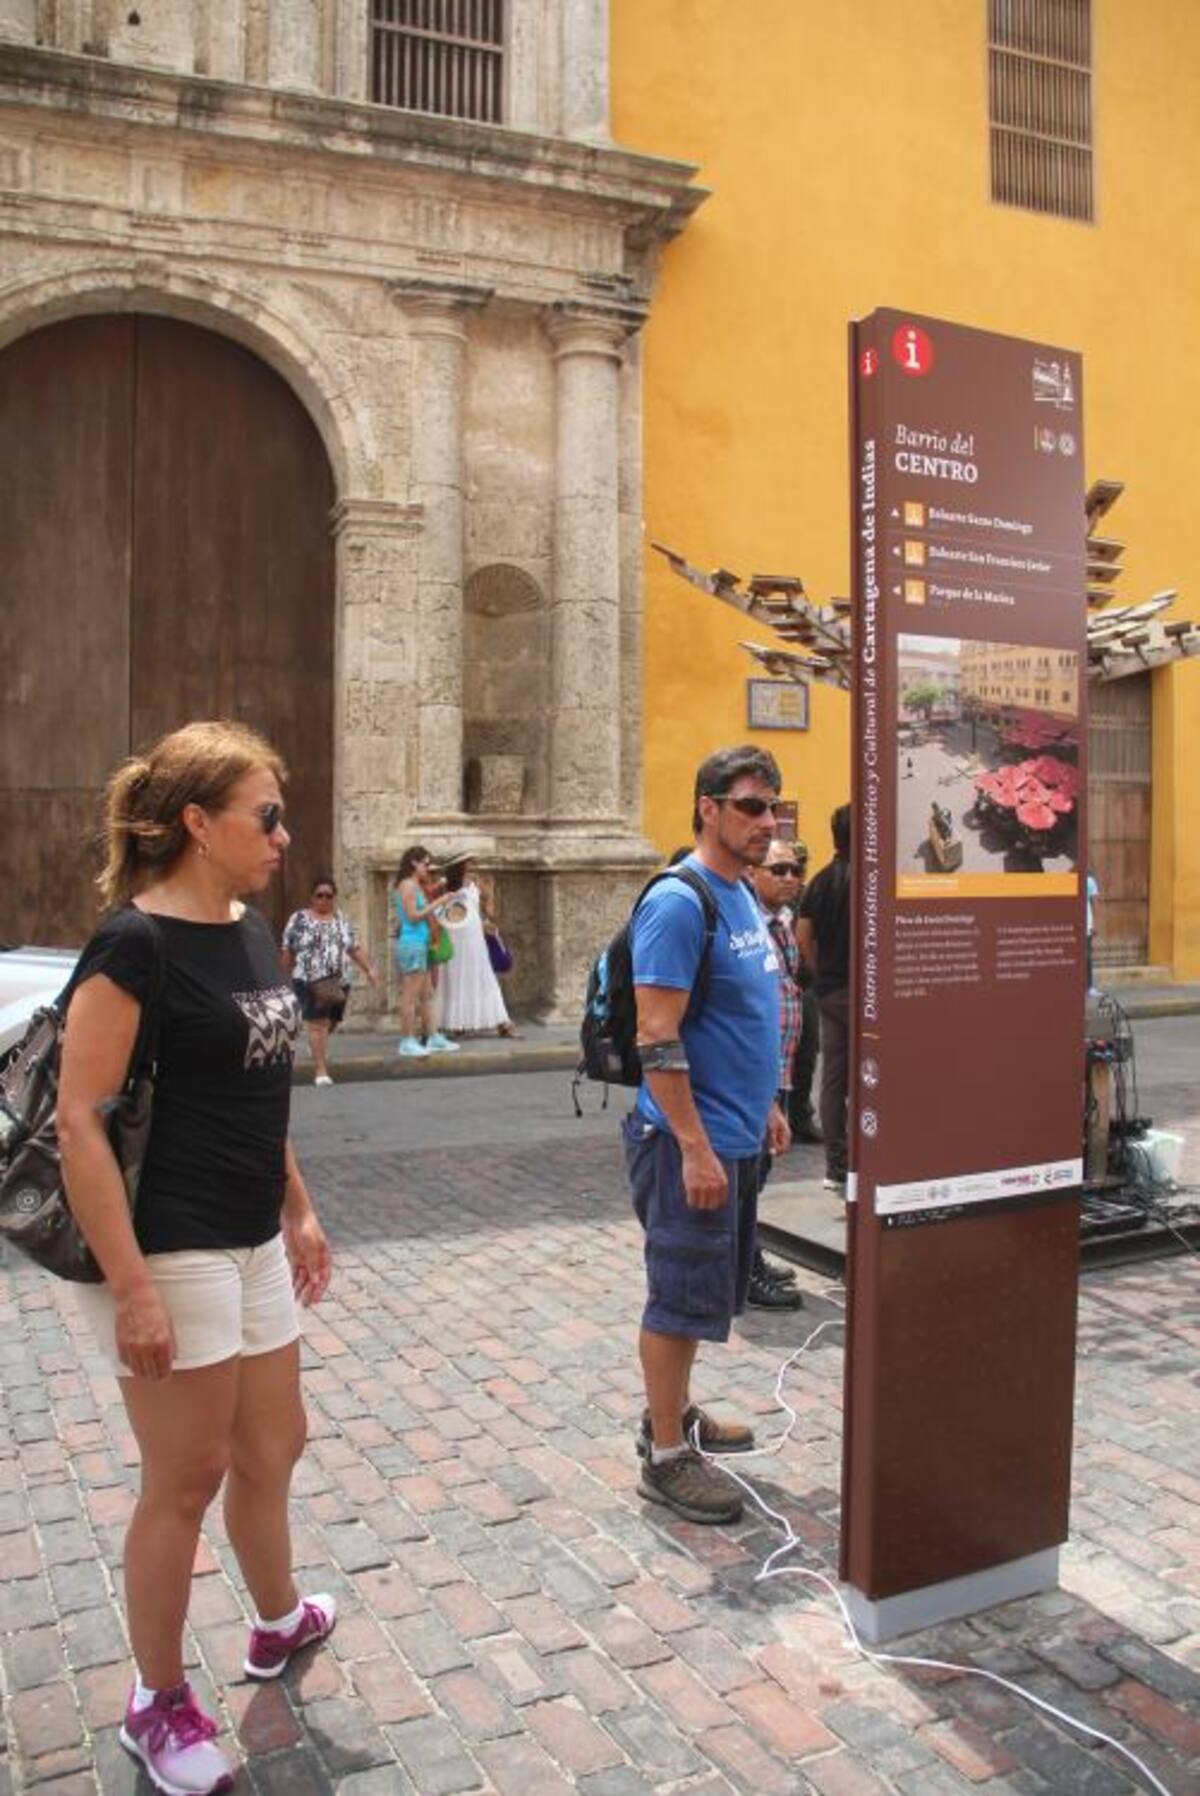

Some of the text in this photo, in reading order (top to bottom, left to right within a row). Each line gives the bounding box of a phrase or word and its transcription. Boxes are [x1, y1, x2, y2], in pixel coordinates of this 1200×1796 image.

[896, 424, 975, 456] Barrio del
[861, 440, 876, 511] Indias
[895, 452, 978, 484] CENTRO
[861, 515, 876, 542] de
[861, 546, 880, 665] Cartagena
[864, 667, 877, 688] de
[863, 692, 878, 767] Cultural
[867, 770, 881, 783] y
[863, 954, 878, 1020] Distrito
